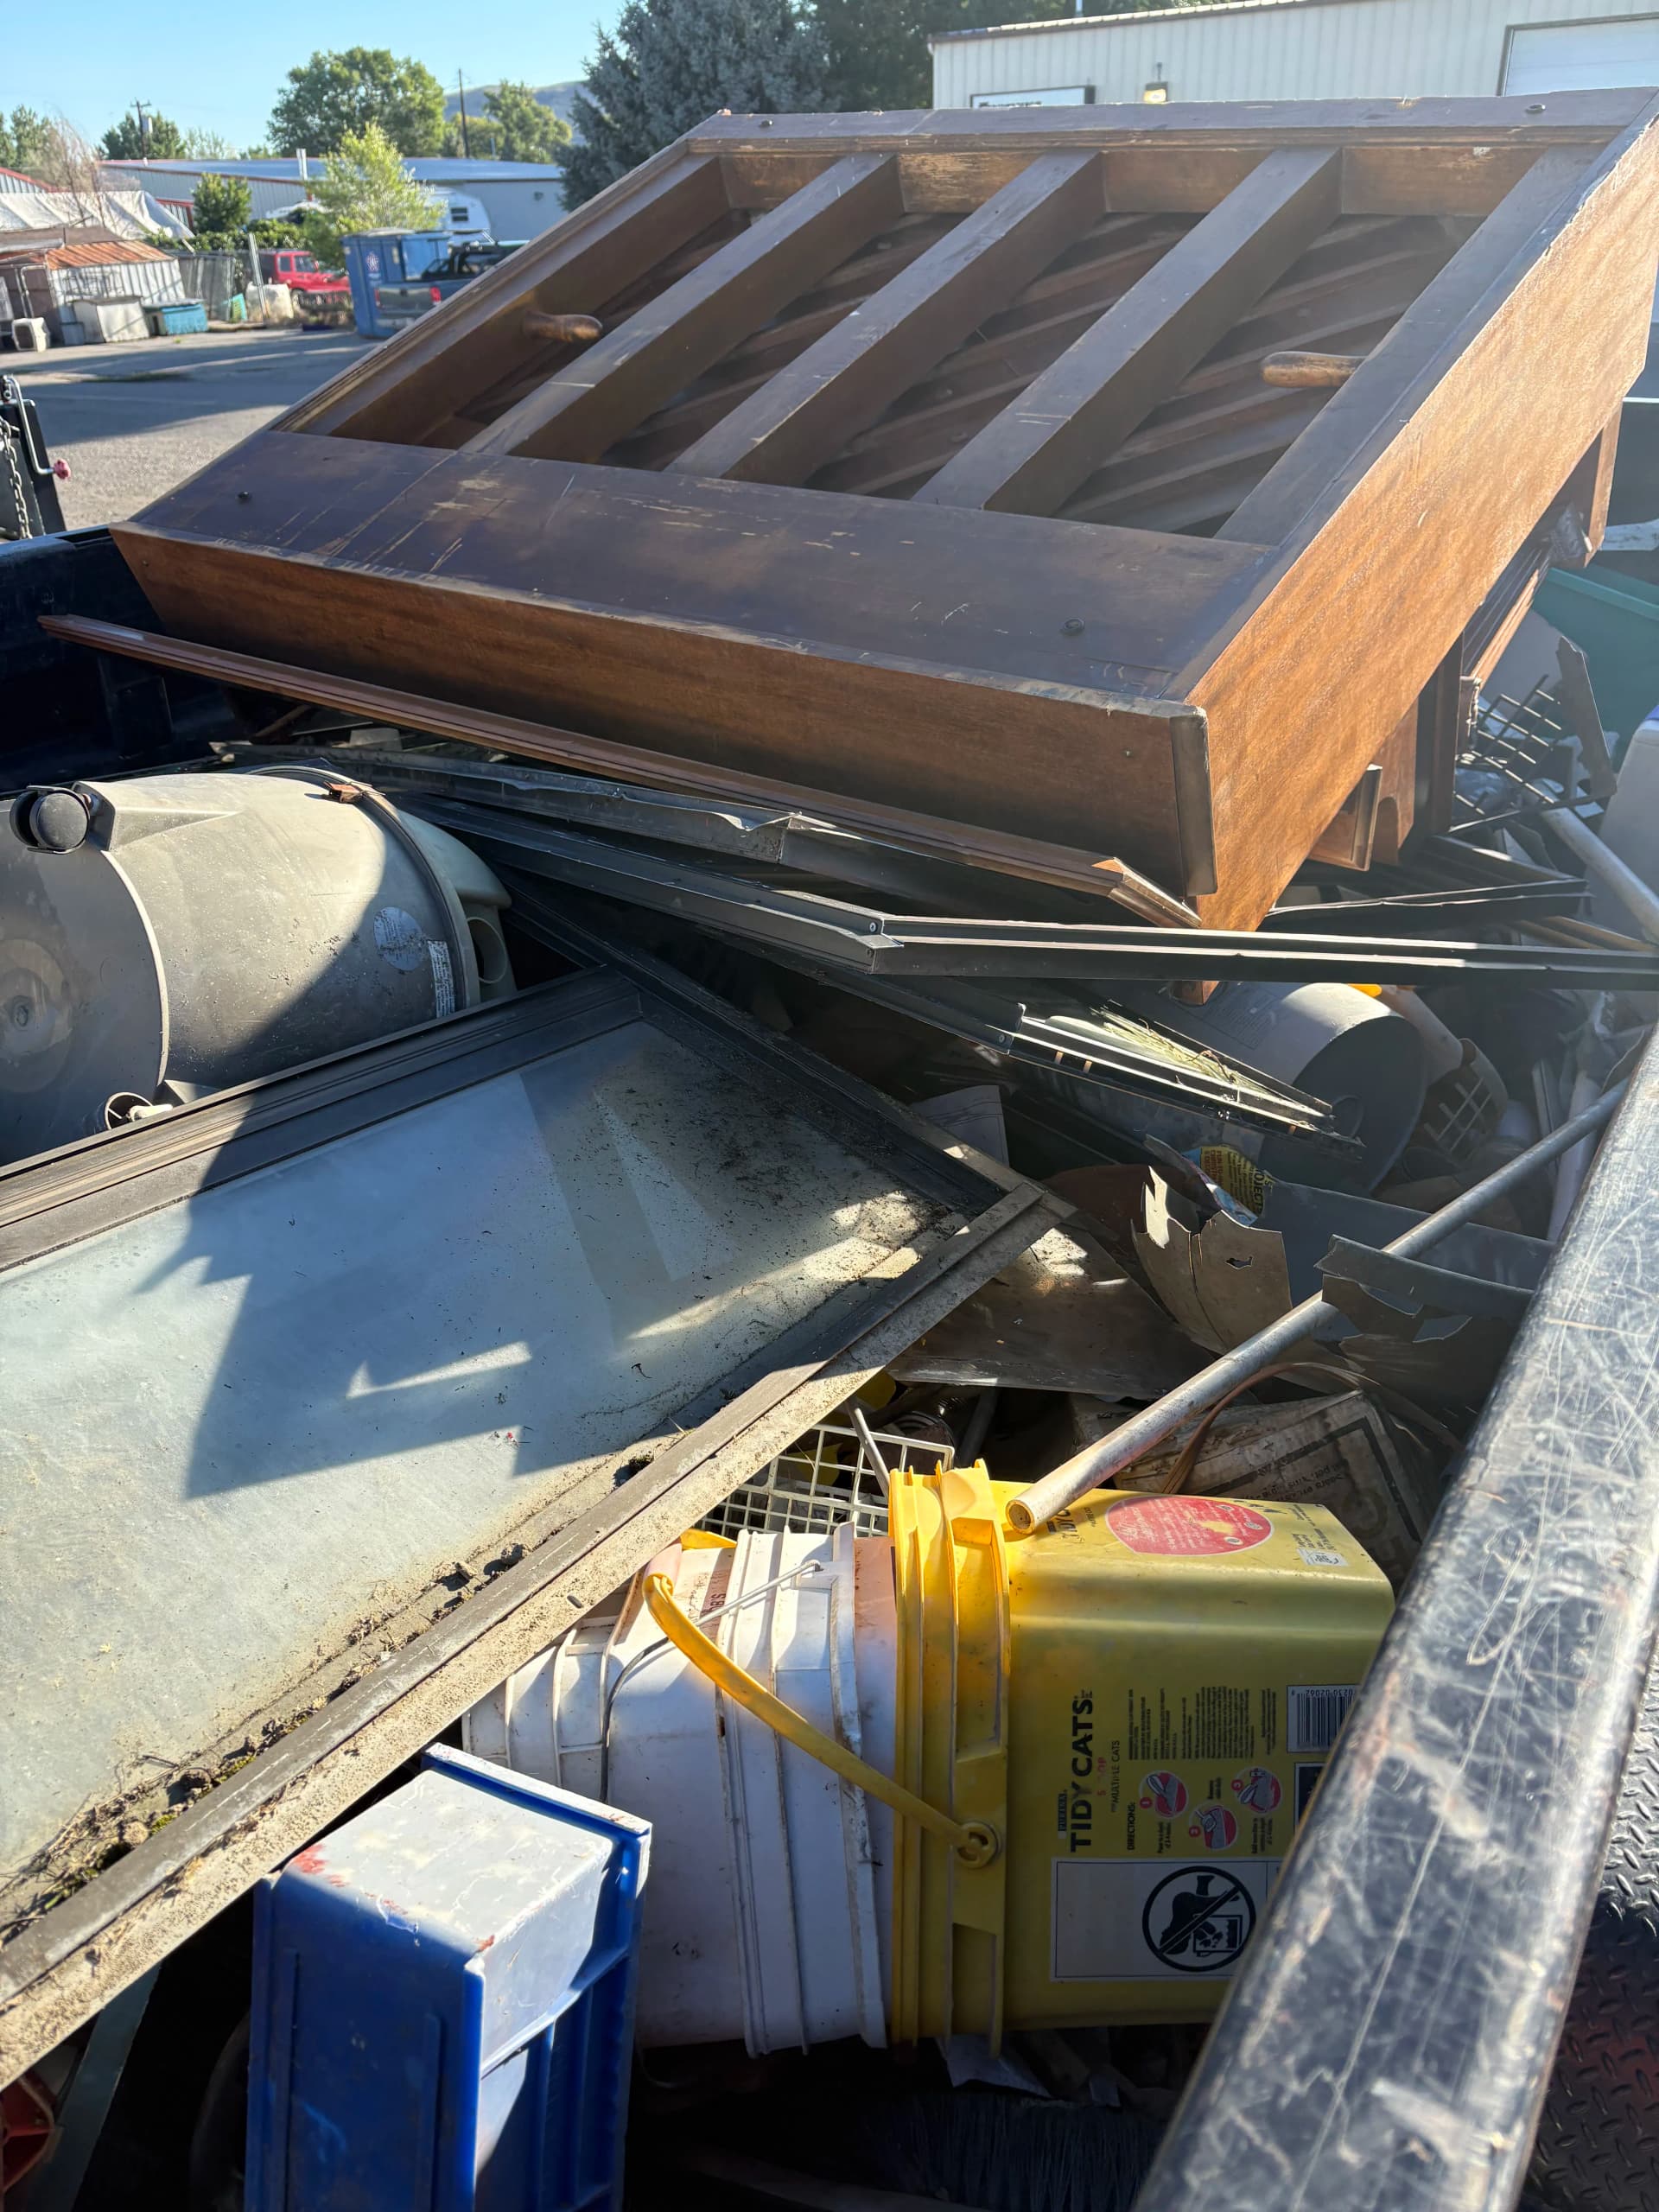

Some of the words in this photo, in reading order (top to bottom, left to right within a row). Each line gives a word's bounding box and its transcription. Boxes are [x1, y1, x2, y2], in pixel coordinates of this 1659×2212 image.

[1071, 1699, 1093, 1778] CATS
[1070, 1780, 1092, 1853] TIDY
[1127, 1802, 1135, 1851] DIRECTIONS:
